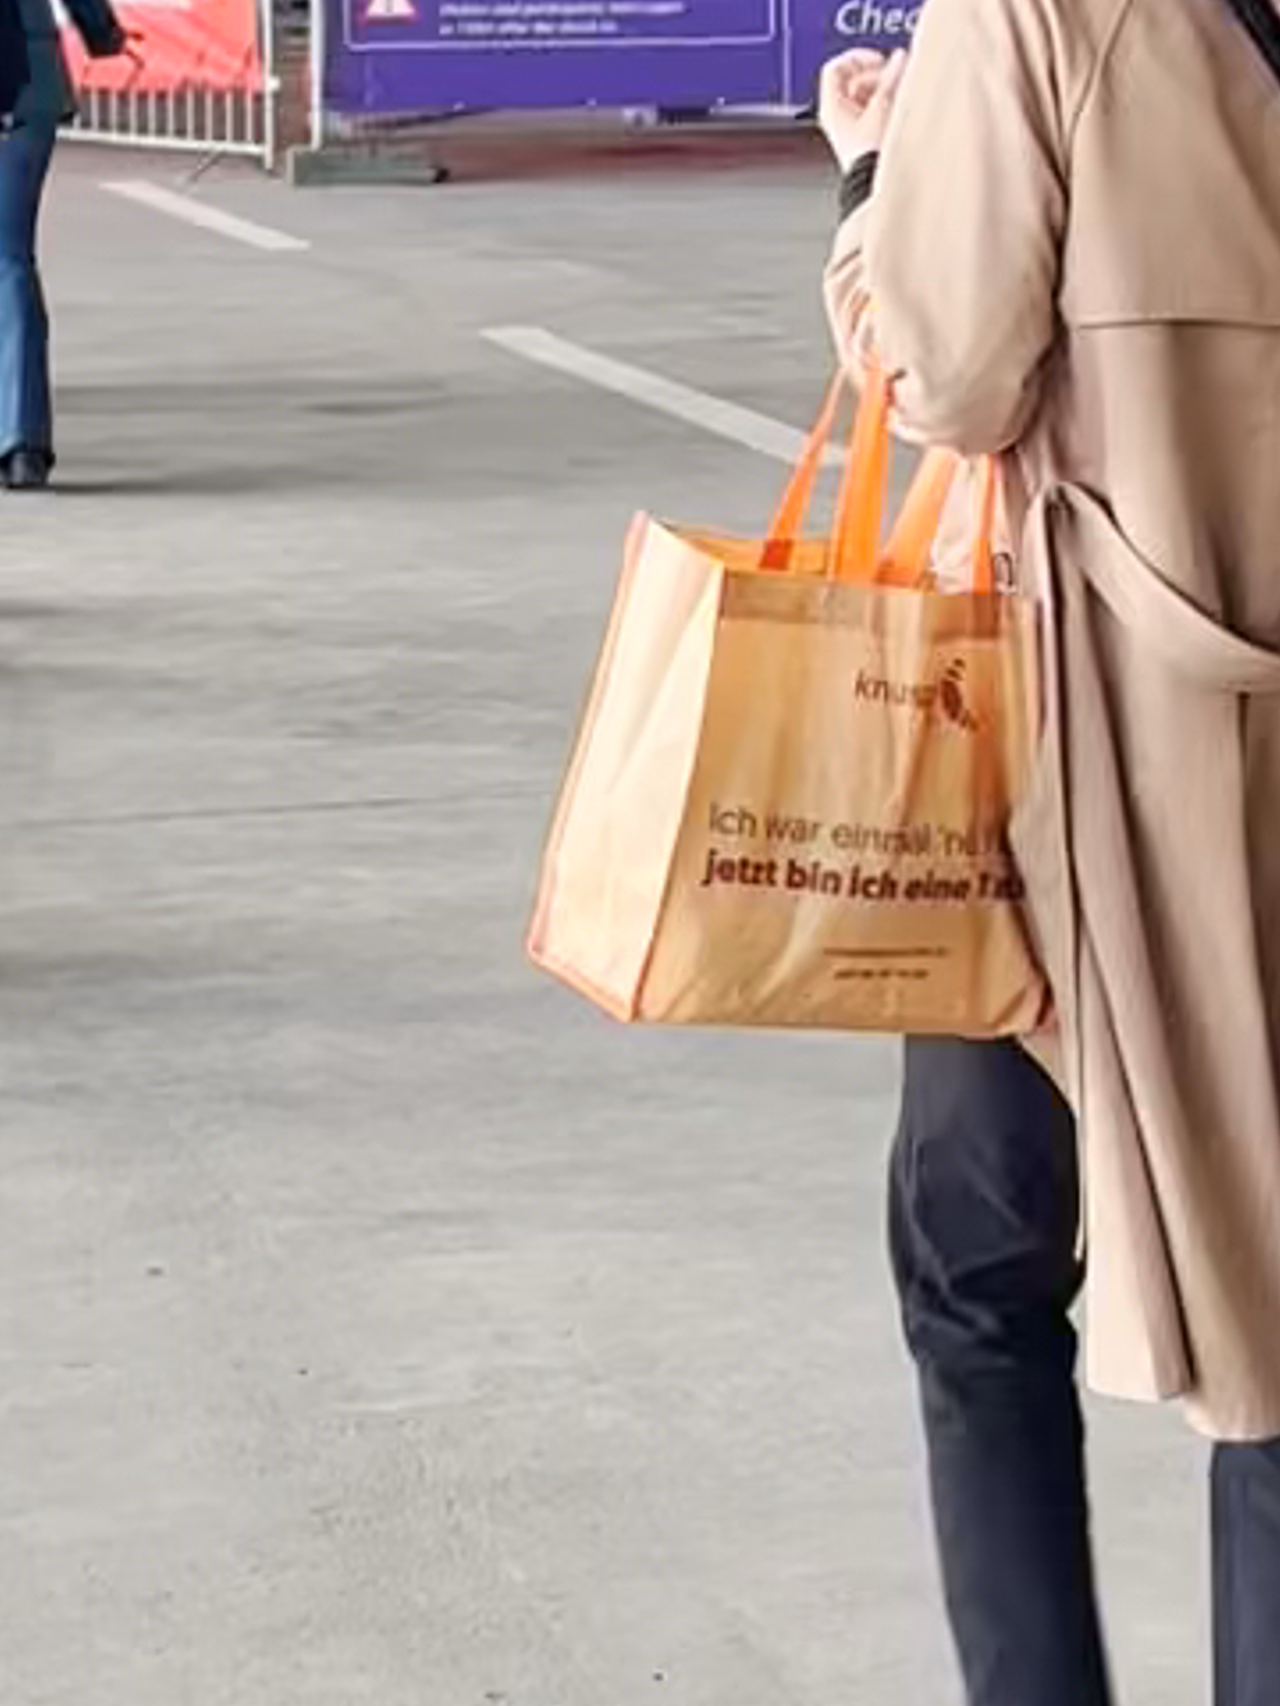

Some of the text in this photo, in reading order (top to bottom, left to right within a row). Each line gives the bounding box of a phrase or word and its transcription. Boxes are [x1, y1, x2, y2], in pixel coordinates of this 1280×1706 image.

[765, 811, 821, 843] war
[702, 847, 778, 887] jetzt
[785, 859, 842, 895] bin
